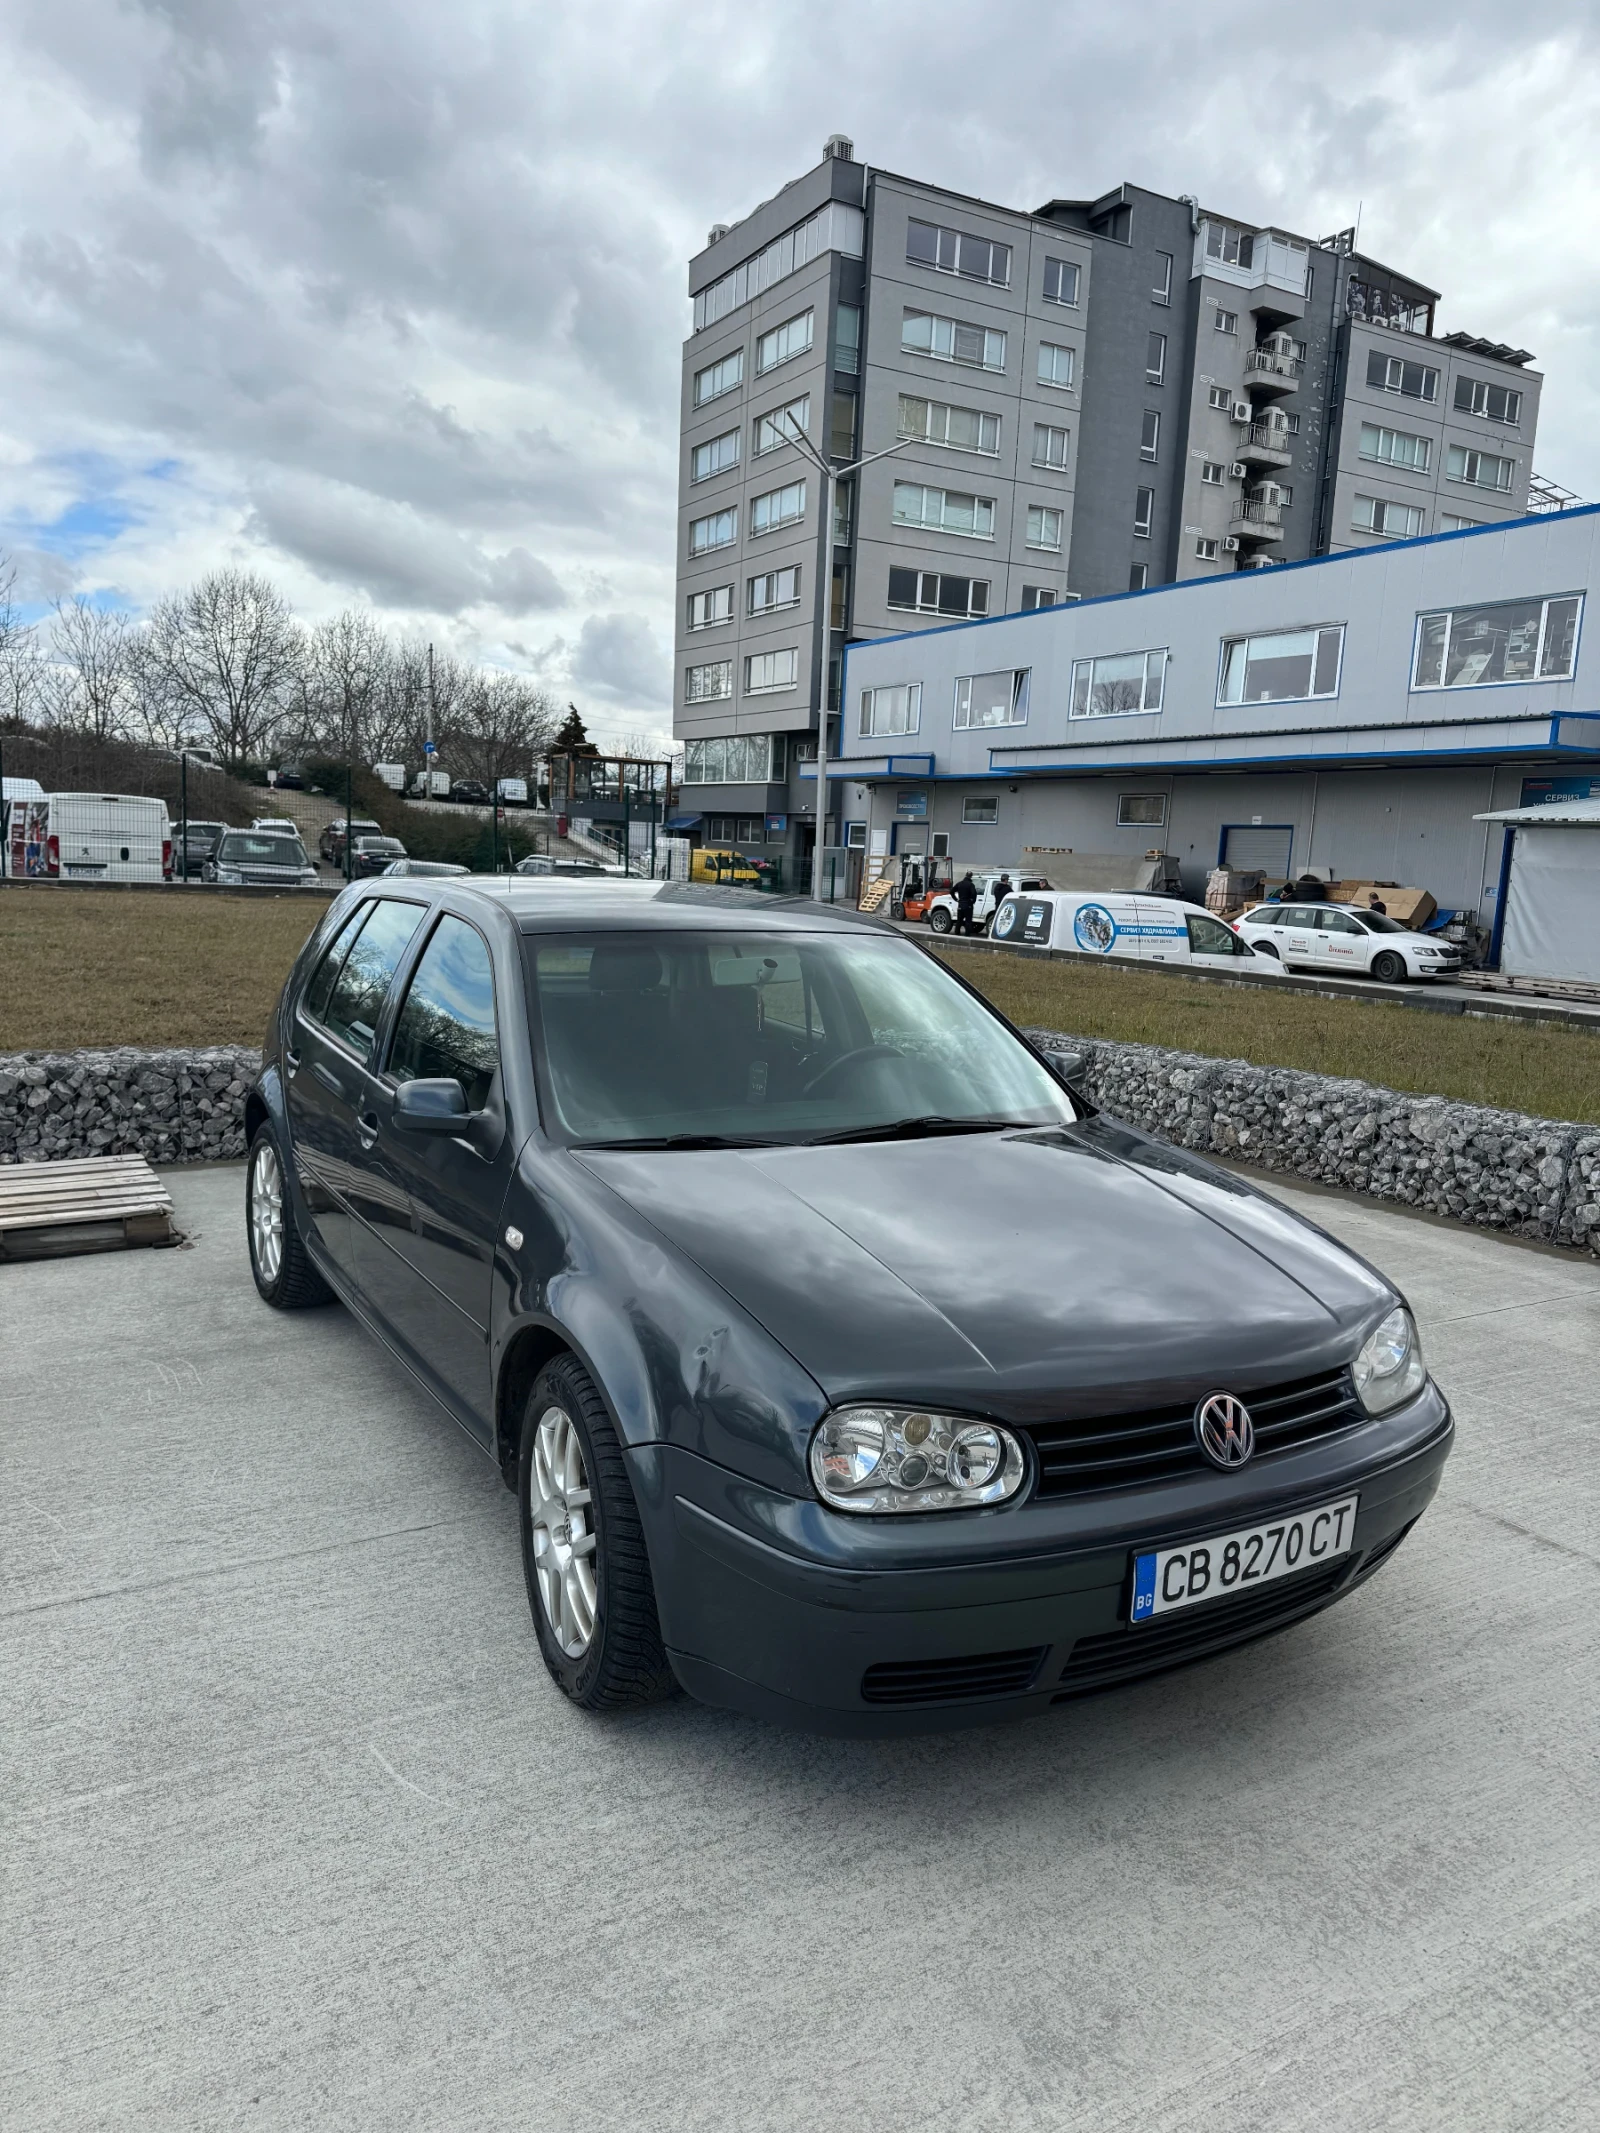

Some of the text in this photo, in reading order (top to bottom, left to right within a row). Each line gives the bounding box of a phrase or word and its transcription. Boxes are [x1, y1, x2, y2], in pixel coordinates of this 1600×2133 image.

[1162, 1504, 1352, 1603] CB 8270 CT
[1136, 1593, 1152, 1610] BG
